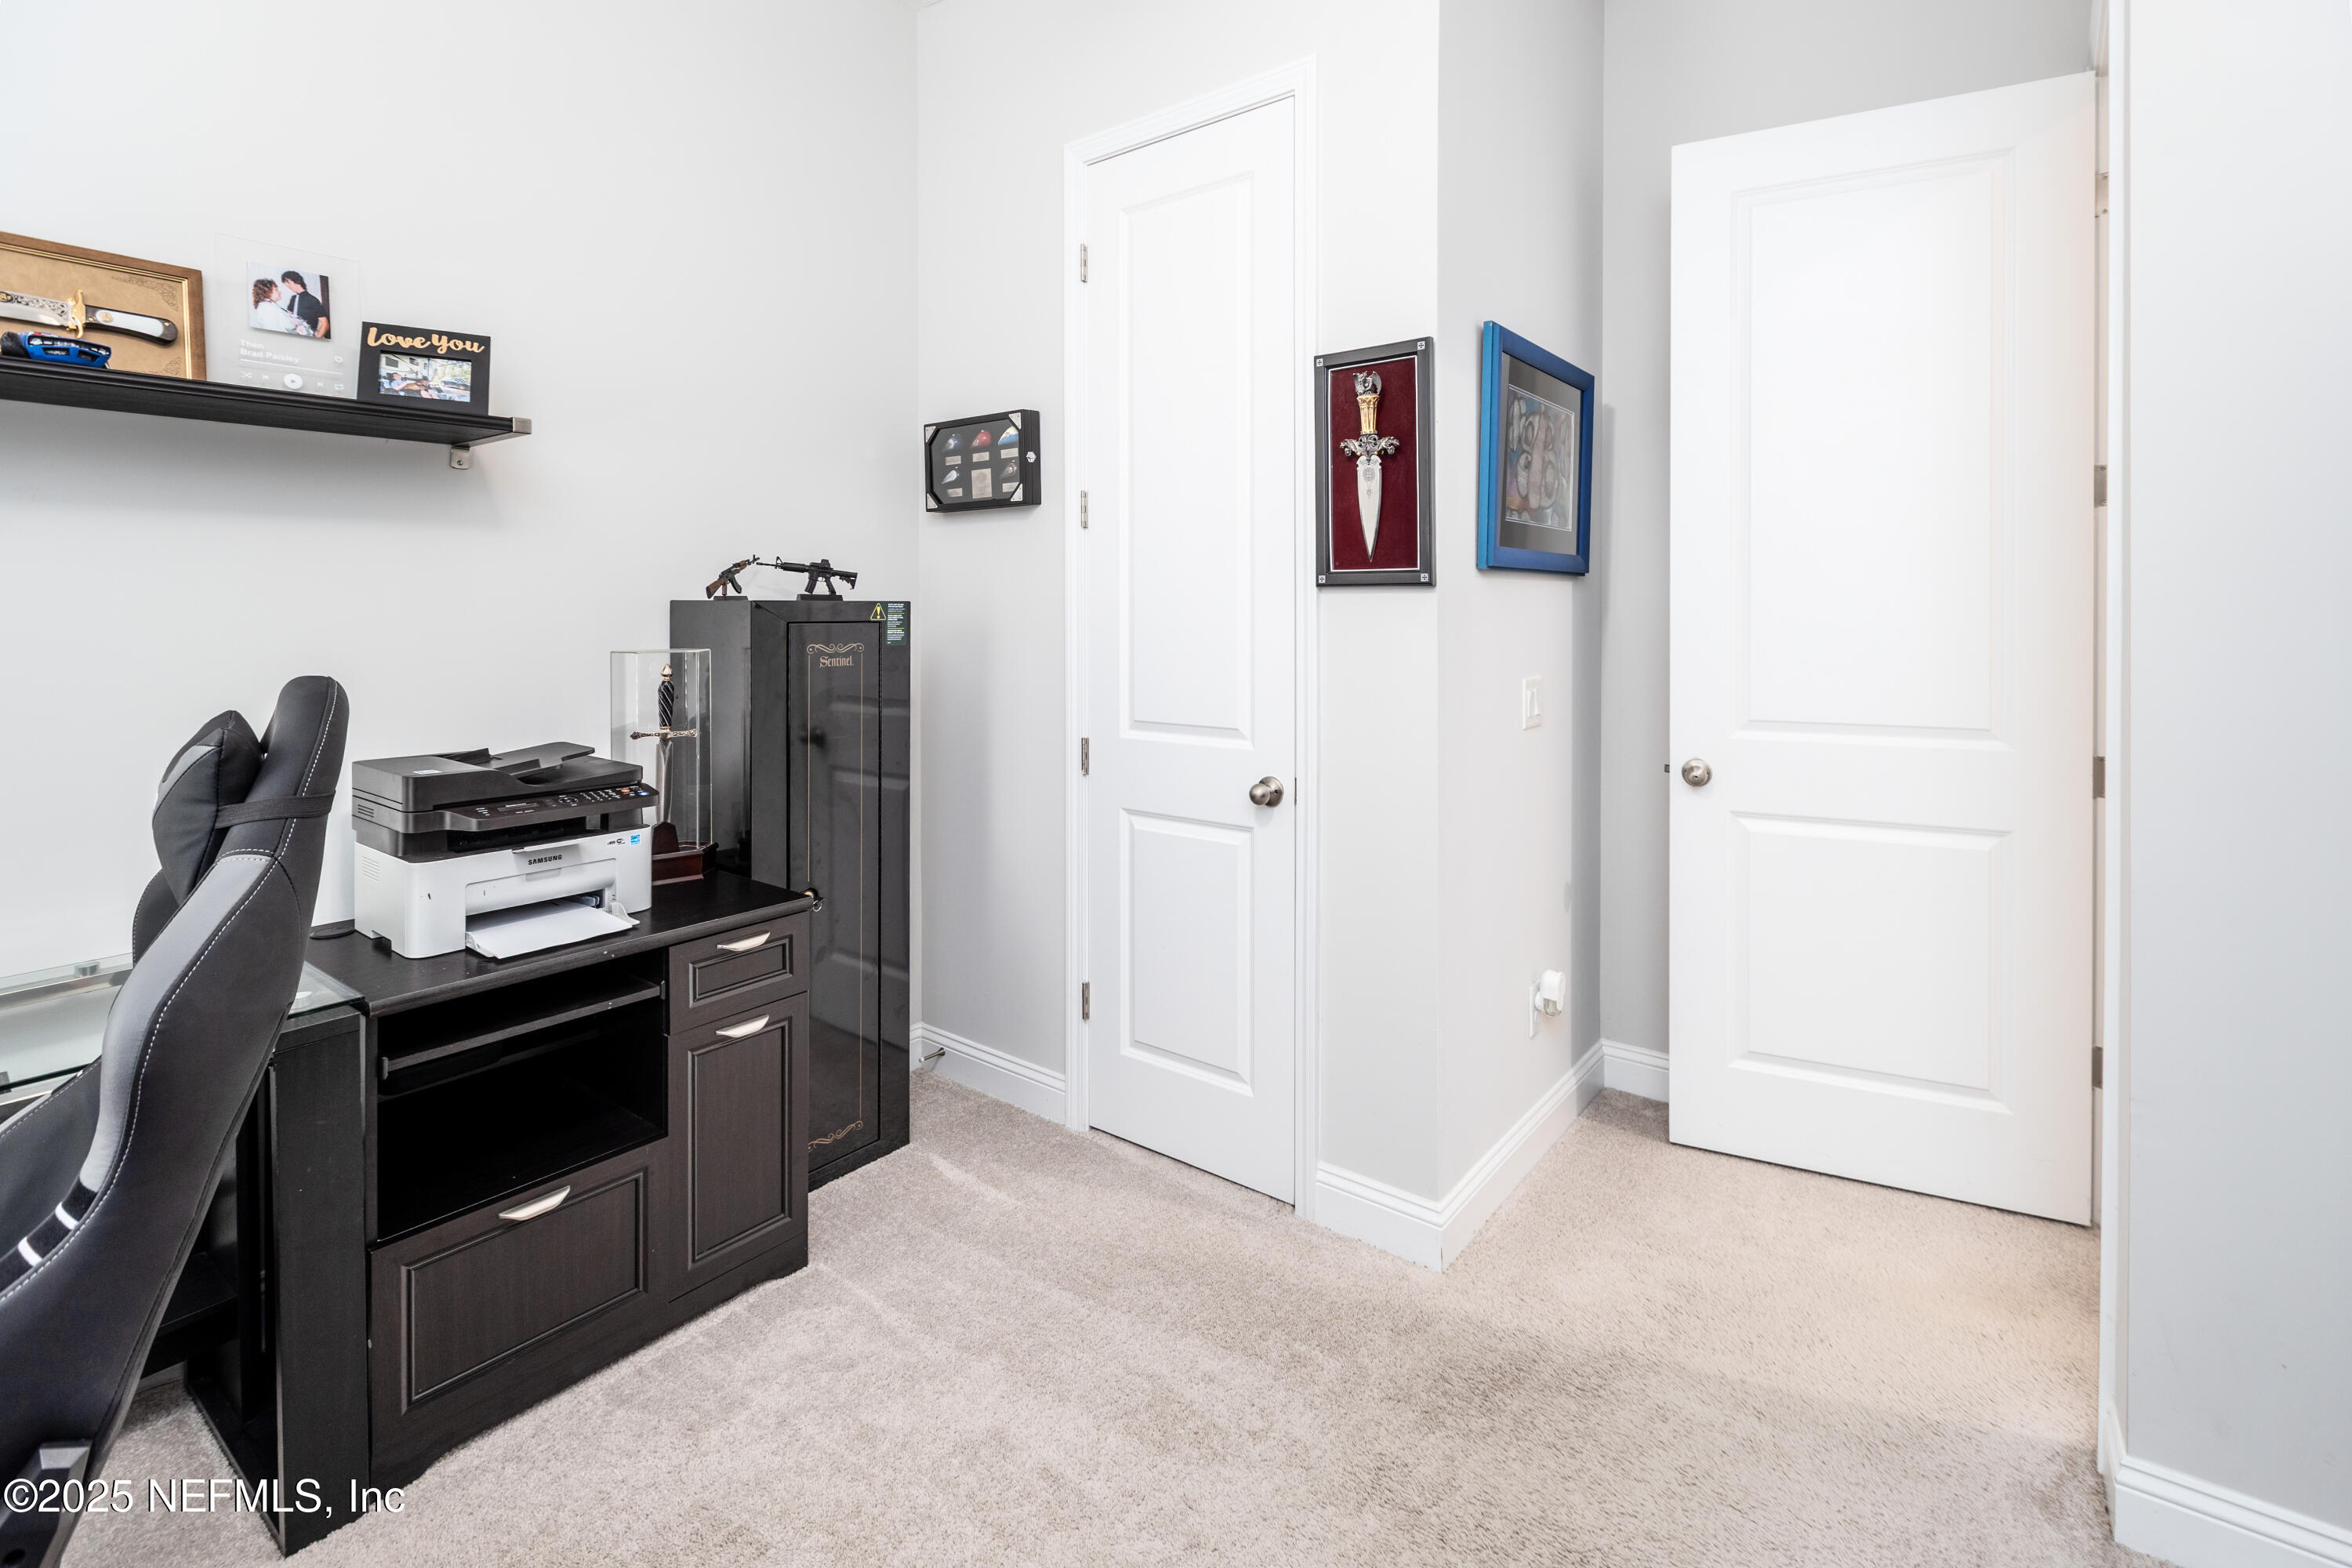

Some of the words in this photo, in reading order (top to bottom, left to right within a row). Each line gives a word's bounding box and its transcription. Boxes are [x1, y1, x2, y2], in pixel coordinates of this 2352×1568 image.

[240, 339, 264, 349] Then
[240, 348, 263, 358] Brad
[266, 351, 299, 364] Paisley
[819, 655, 852, 669] Sentinel
[528, 855, 562, 865] SAMSUNG
